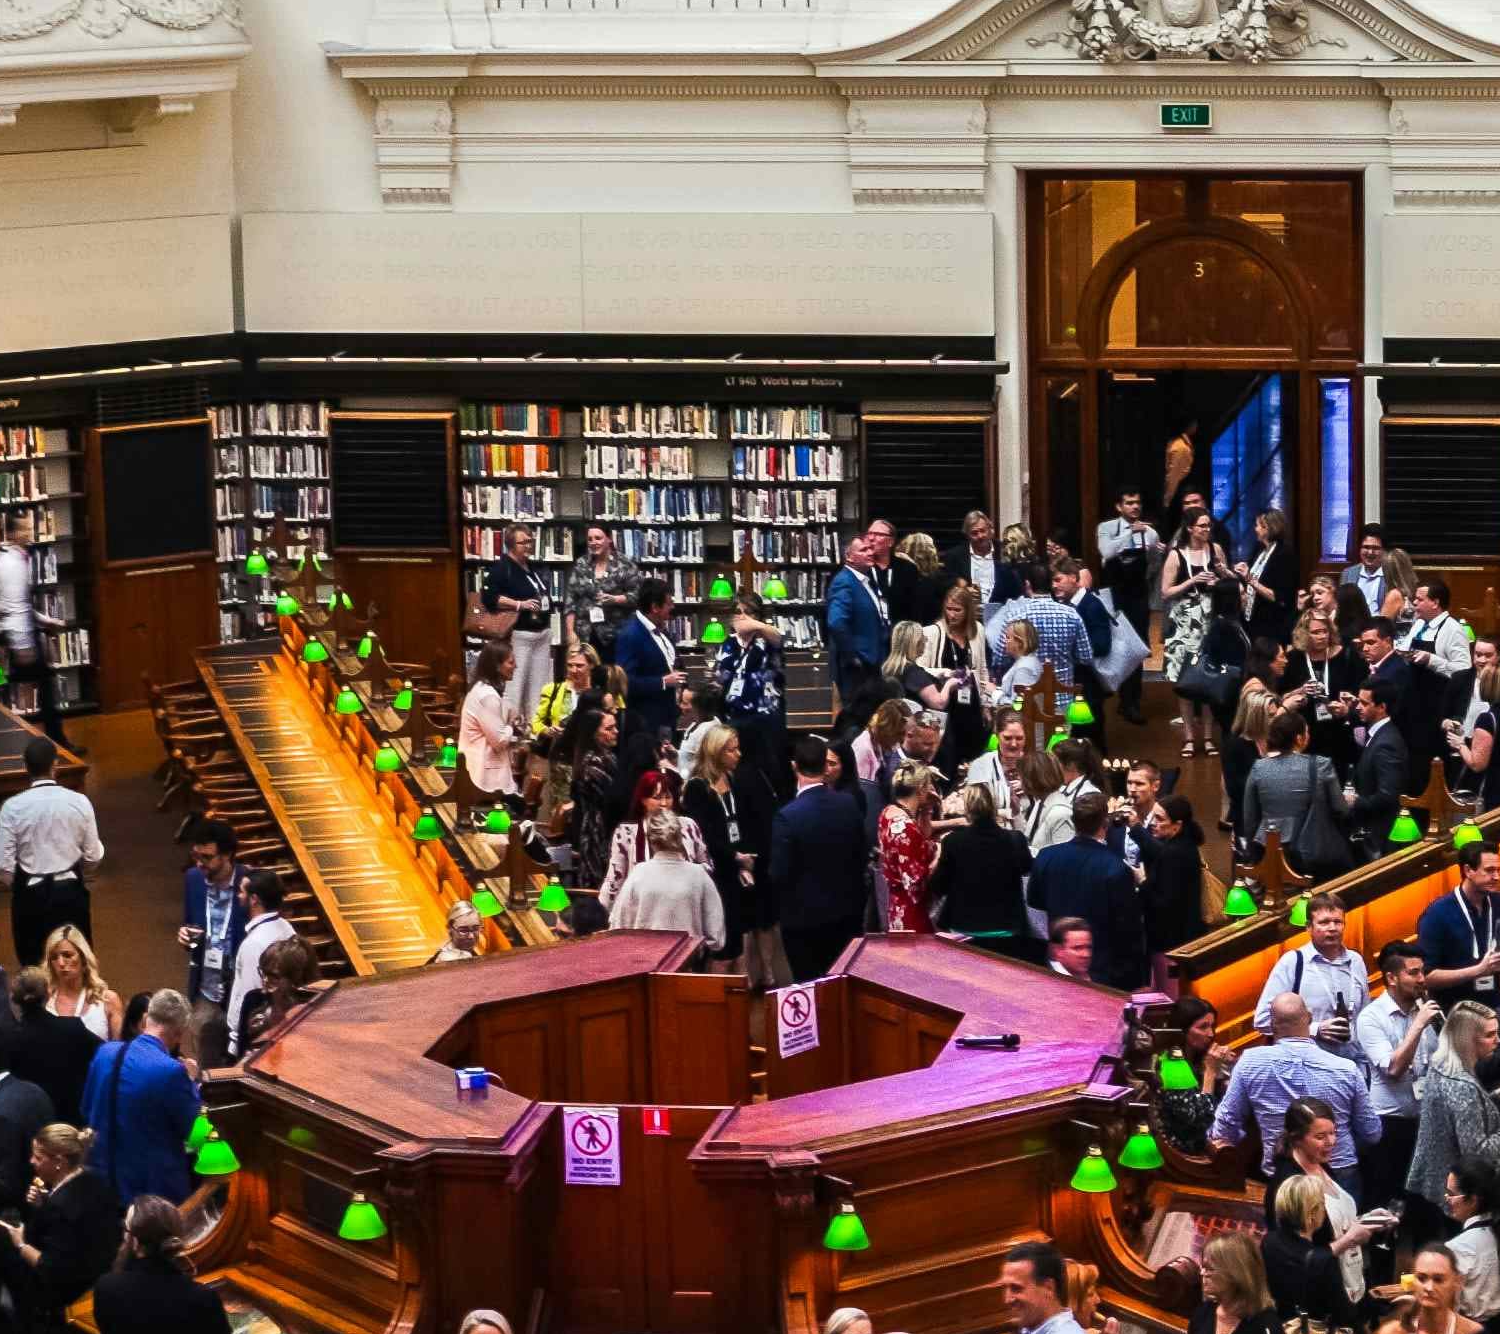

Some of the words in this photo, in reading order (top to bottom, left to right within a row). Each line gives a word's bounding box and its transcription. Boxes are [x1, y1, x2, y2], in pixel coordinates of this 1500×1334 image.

[1172, 107, 1198, 123] EXIT
[1193, 261, 1205, 278] 3
[762, 377, 789, 386] World
[792, 378, 808, 386] war
[811, 376, 843, 388] history
